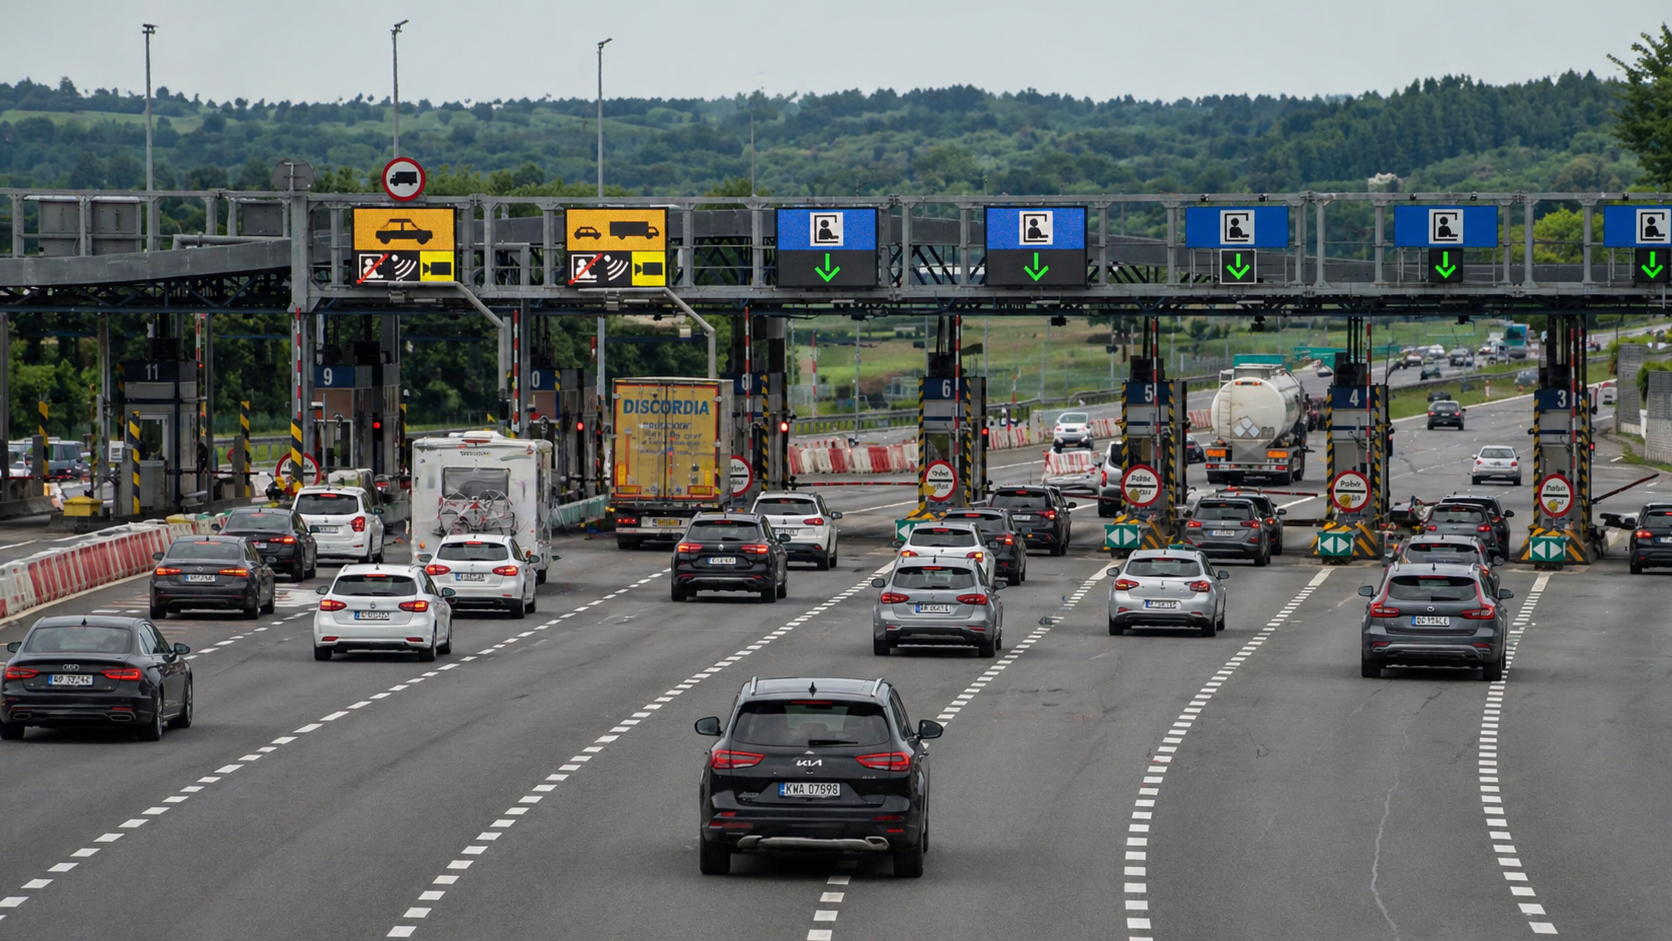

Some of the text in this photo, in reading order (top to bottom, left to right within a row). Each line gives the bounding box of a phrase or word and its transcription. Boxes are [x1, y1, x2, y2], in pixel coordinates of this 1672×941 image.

[145, 363, 158, 380] 11
[323, 367, 333, 386] 9
[942, 379, 951, 398] 6
[1144, 384, 1154, 403] 5
[1349, 388, 1360, 407] 4
[623, 399, 710, 415] DISCORDIA
[1557, 389, 1567, 408] 3
[796, 759, 823, 767] KIA
[786, 784, 805, 795] KWA
